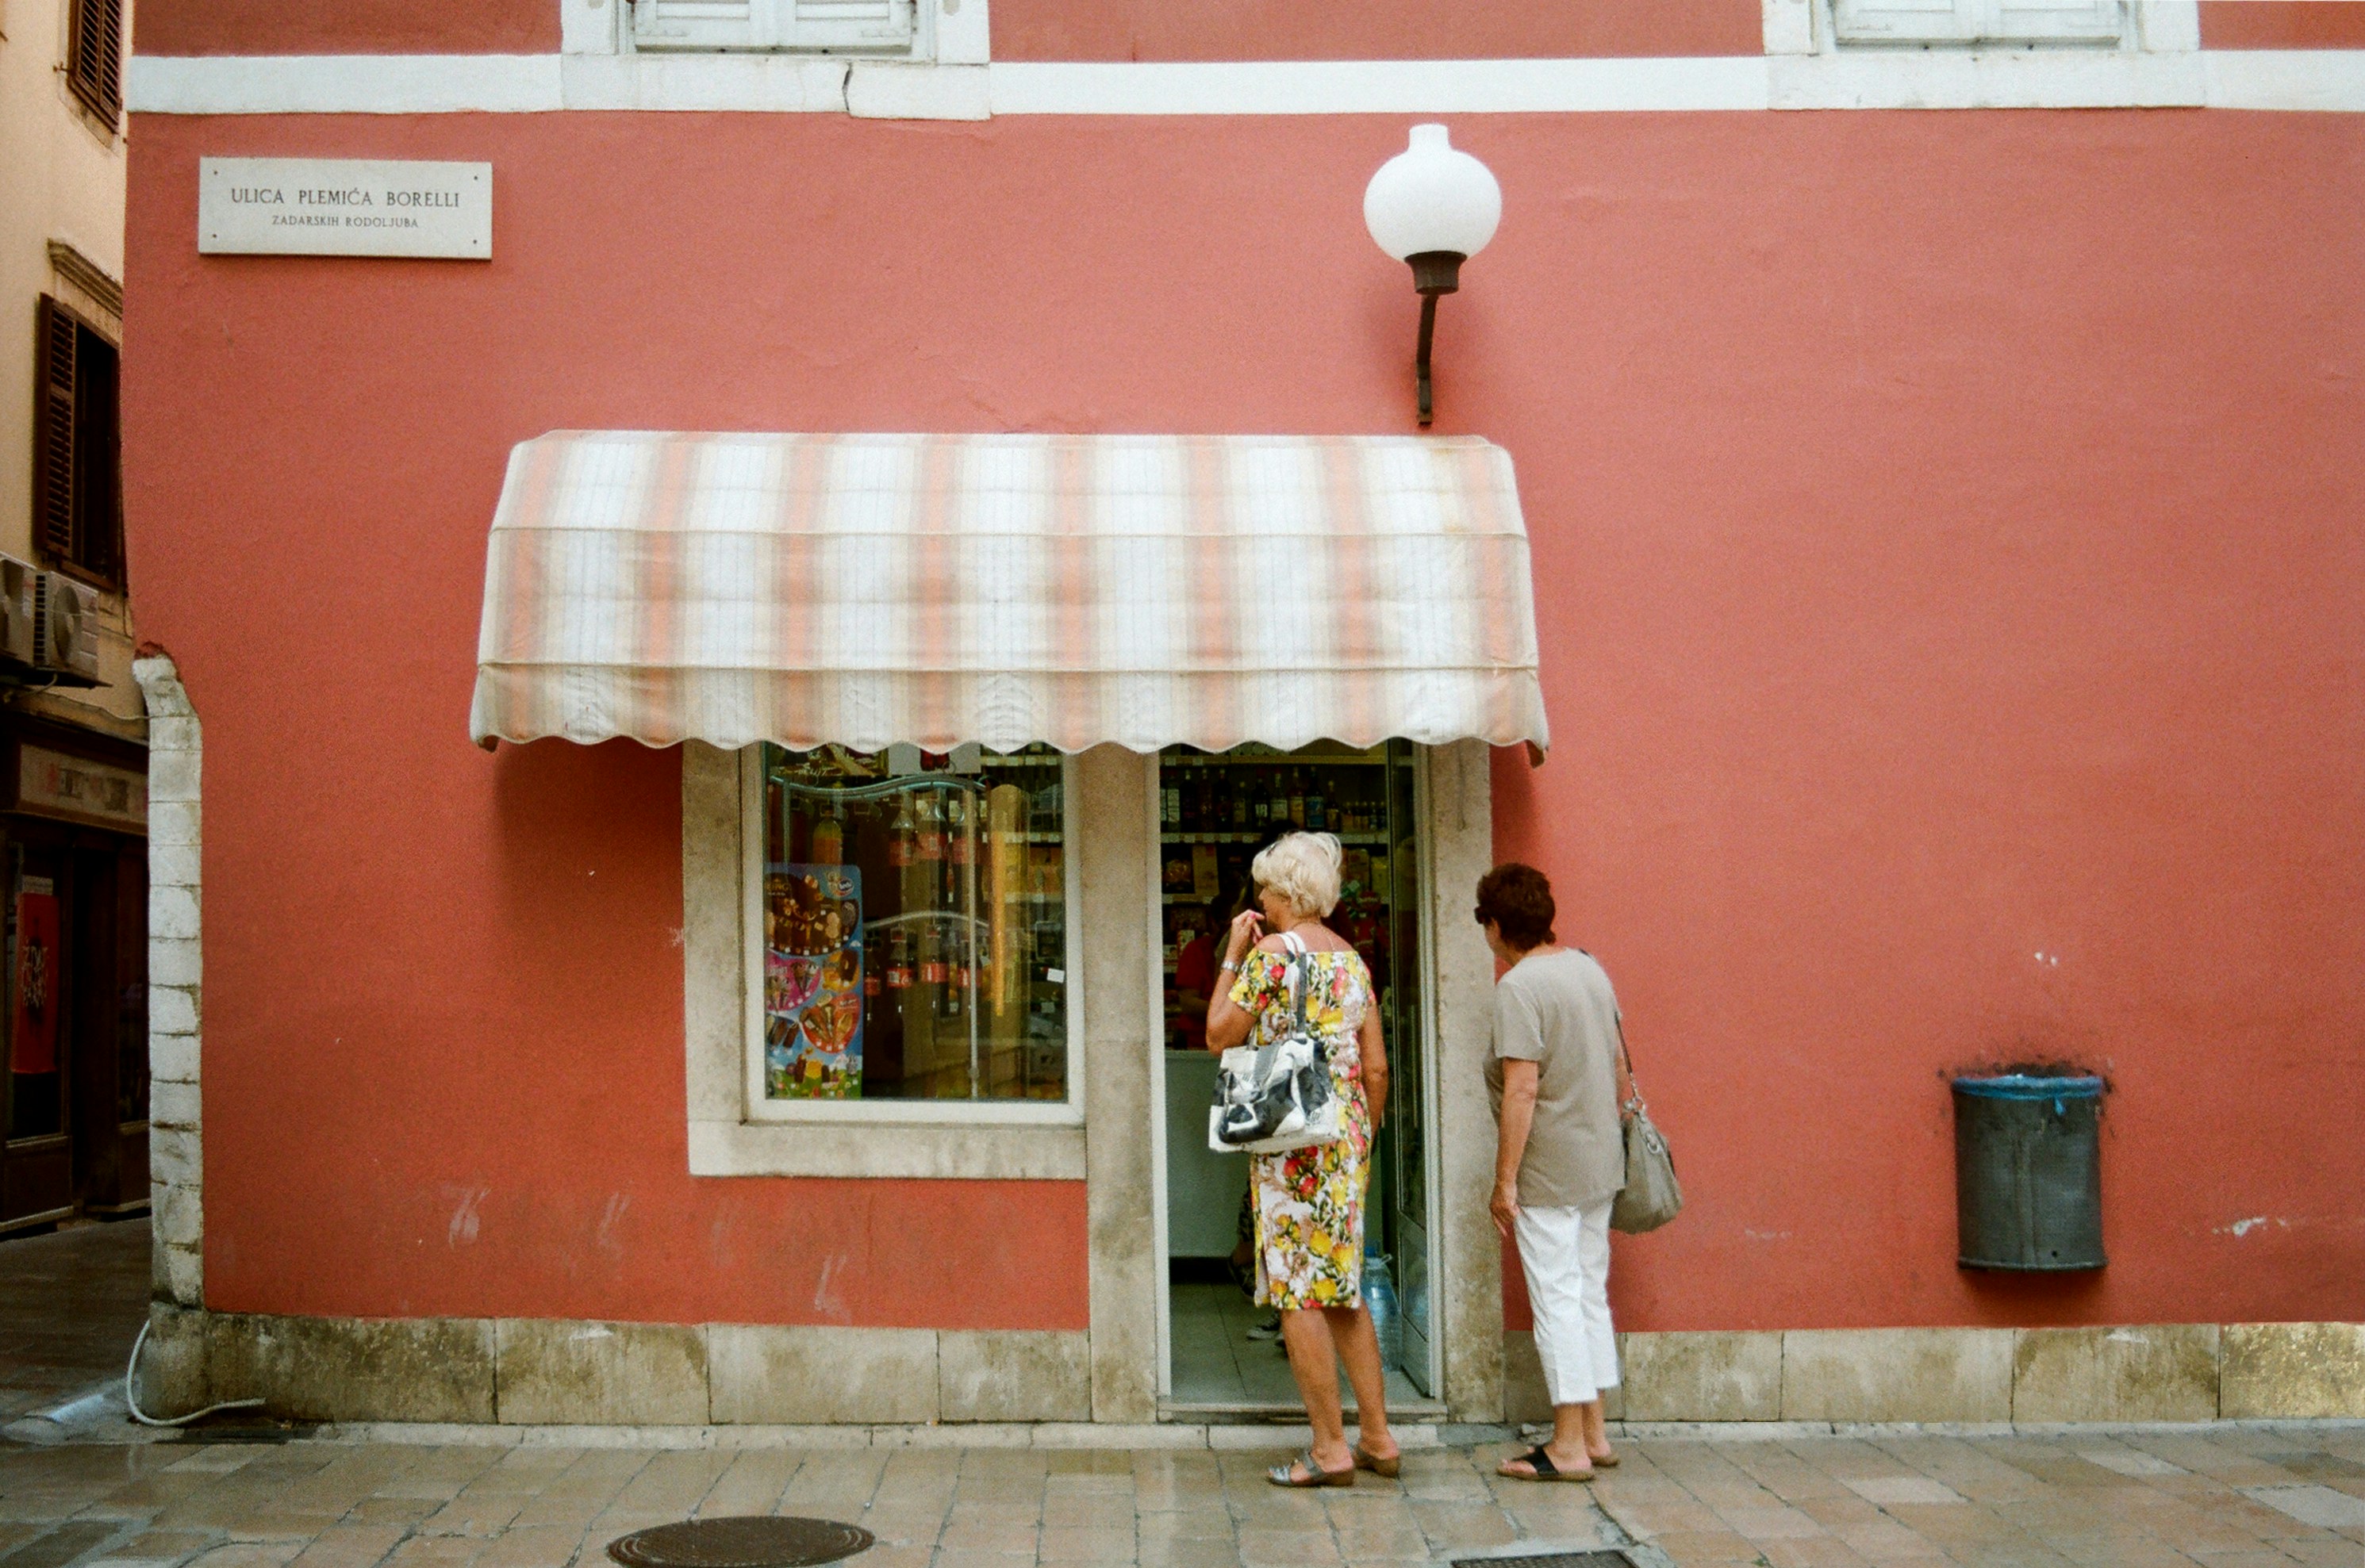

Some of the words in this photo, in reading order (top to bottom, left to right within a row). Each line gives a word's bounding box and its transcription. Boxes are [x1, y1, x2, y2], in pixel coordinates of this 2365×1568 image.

[232, 189, 284, 203] ULICA
[299, 188, 372, 206] PLEMIĆA
[386, 192, 460, 207] BORELLI
[272, 216, 339, 227] ZADARSKIH
[346, 217, 419, 228] RODOLJUBA
